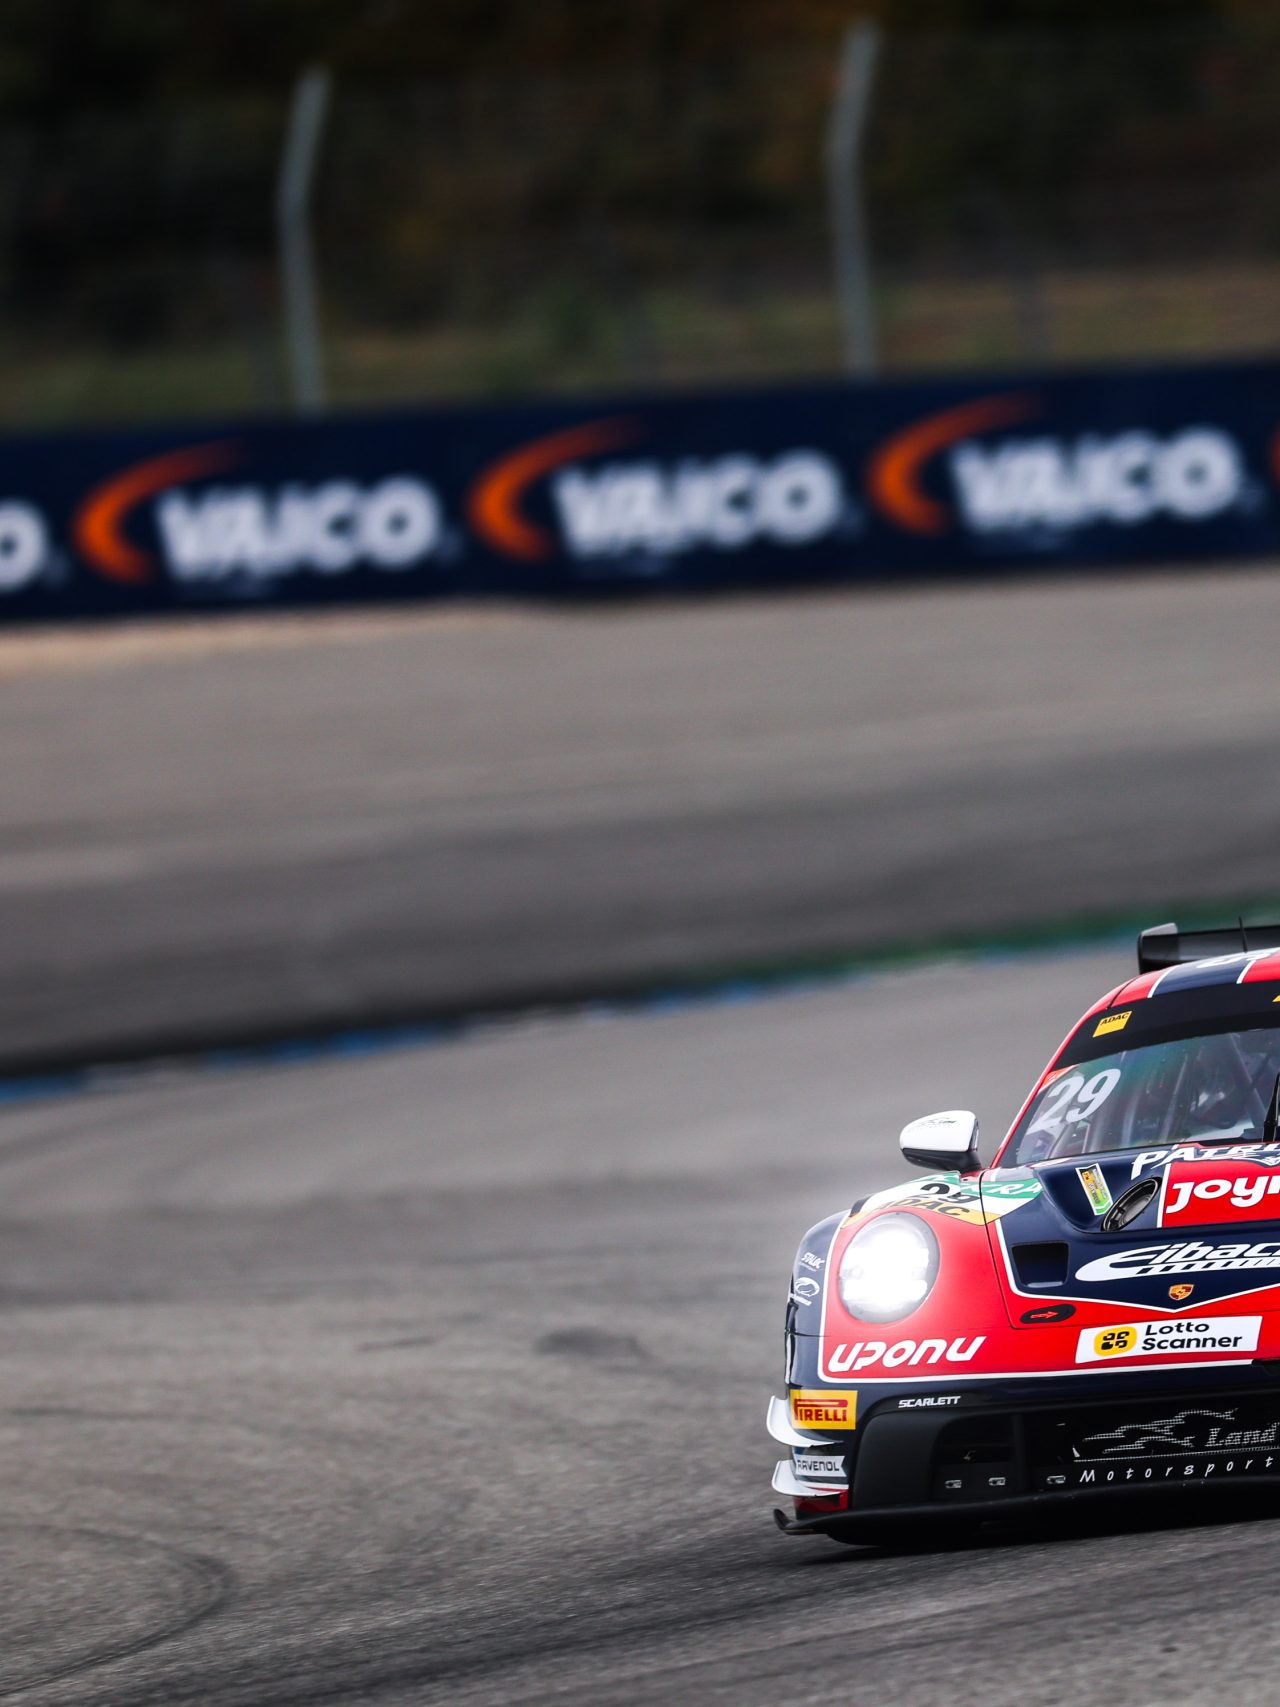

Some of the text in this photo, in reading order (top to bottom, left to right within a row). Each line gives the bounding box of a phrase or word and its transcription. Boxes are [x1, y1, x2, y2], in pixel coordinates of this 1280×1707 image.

[1101, 1012, 1130, 1026] ADAC
[1026, 1068, 1121, 1135] 29
[1145, 1322, 1210, 1336] Lotto
[1142, 1335, 1243, 1351] Scanner
[794, 1396, 848, 1421] PIRELLI
[898, 1395, 962, 1409] SCARLETT
[1204, 1421, 1280, 1447] Land
[797, 1459, 840, 1472] RAVENOL
[1079, 1456, 1274, 1483] Motorsport
